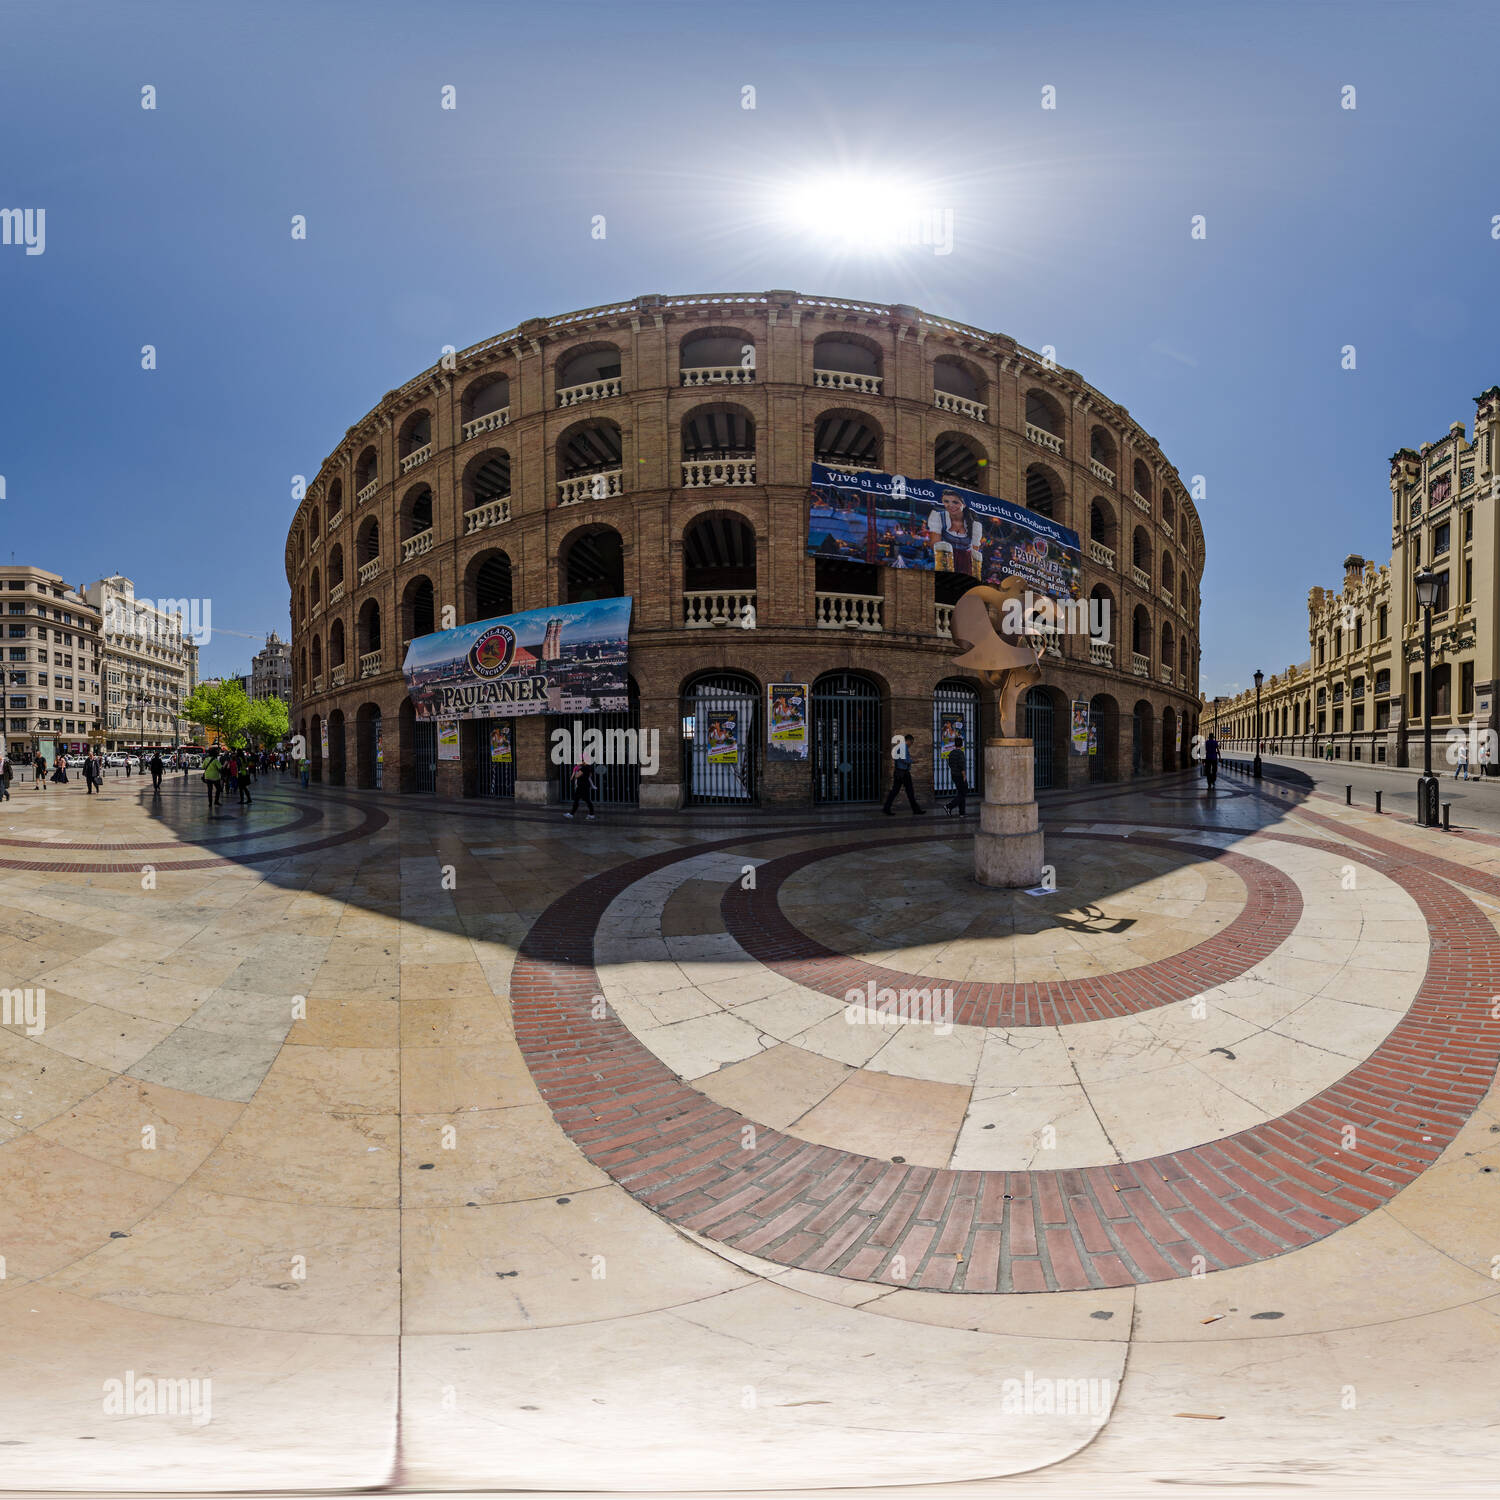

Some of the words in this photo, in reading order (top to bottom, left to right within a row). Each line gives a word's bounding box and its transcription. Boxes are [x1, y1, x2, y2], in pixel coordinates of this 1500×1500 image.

[826, 472, 858, 483] Vive
[861, 479, 872, 488] el
[475, 628, 513, 648] PAULANER
[475, 660, 508, 676] MÜNCHEN
[442, 675, 548, 708] PAULANER
